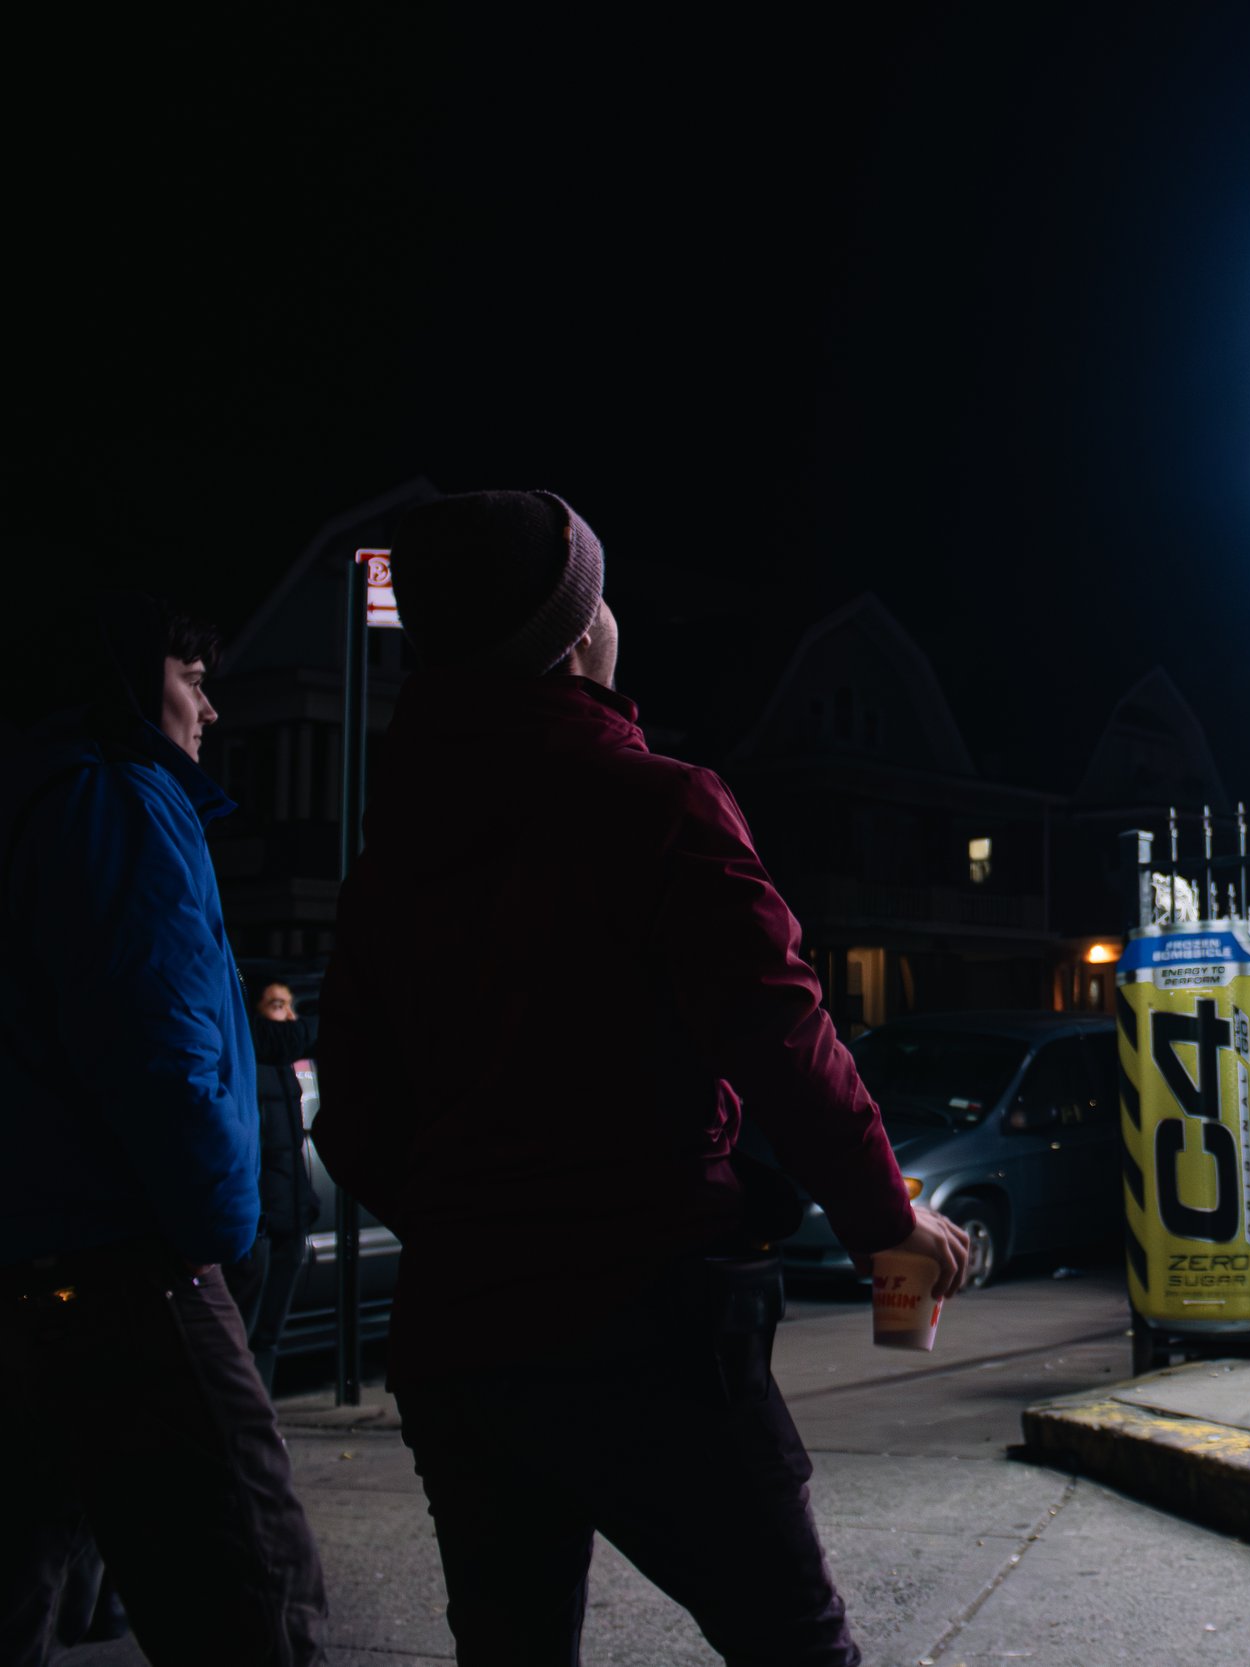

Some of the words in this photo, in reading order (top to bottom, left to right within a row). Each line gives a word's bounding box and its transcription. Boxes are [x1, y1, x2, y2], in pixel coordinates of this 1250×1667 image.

[1164, 938, 1221, 951] FROZEN
[1161, 967, 1208, 978] ENERGY
[1211, 966, 1226, 975] TO
[1164, 975, 1220, 986] PERFORM
[1150, 997, 1240, 1244] C4
[1168, 1254, 1250, 1271] ZERO
[1168, 1275, 1247, 1287] SUGAR
